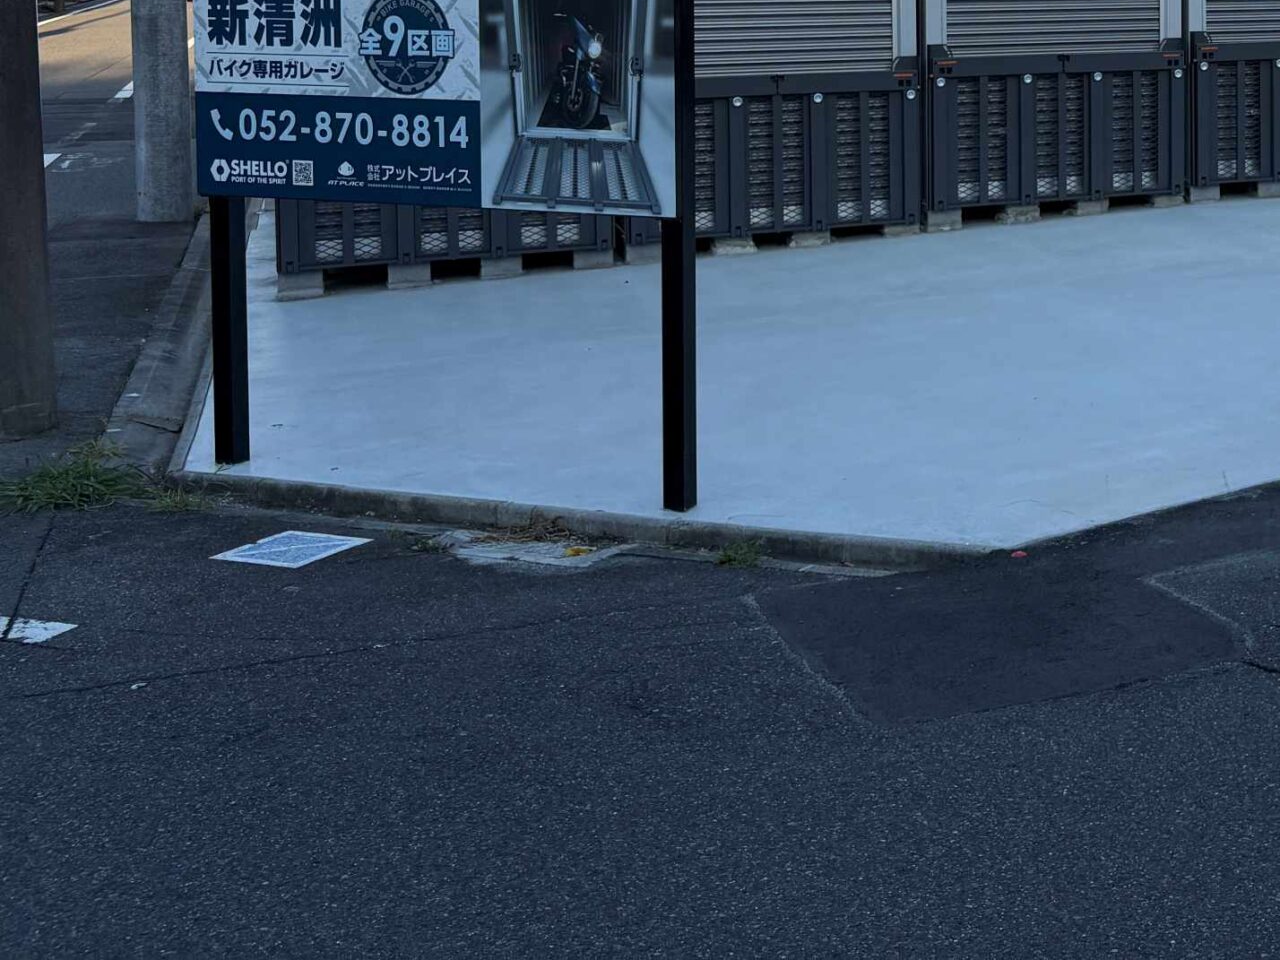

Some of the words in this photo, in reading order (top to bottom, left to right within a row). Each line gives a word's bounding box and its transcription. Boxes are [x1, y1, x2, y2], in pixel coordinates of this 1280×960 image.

[380, 0, 397, 17] BIKE
[400, 0, 430, 17] GARAGE
[359, 15, 455, 58] 全9区画
[209, 58, 345, 80] バイク専用ガレージ
[239, 108, 469, 148] 052-870-8814
[231, 159, 288, 177] SHELLO
